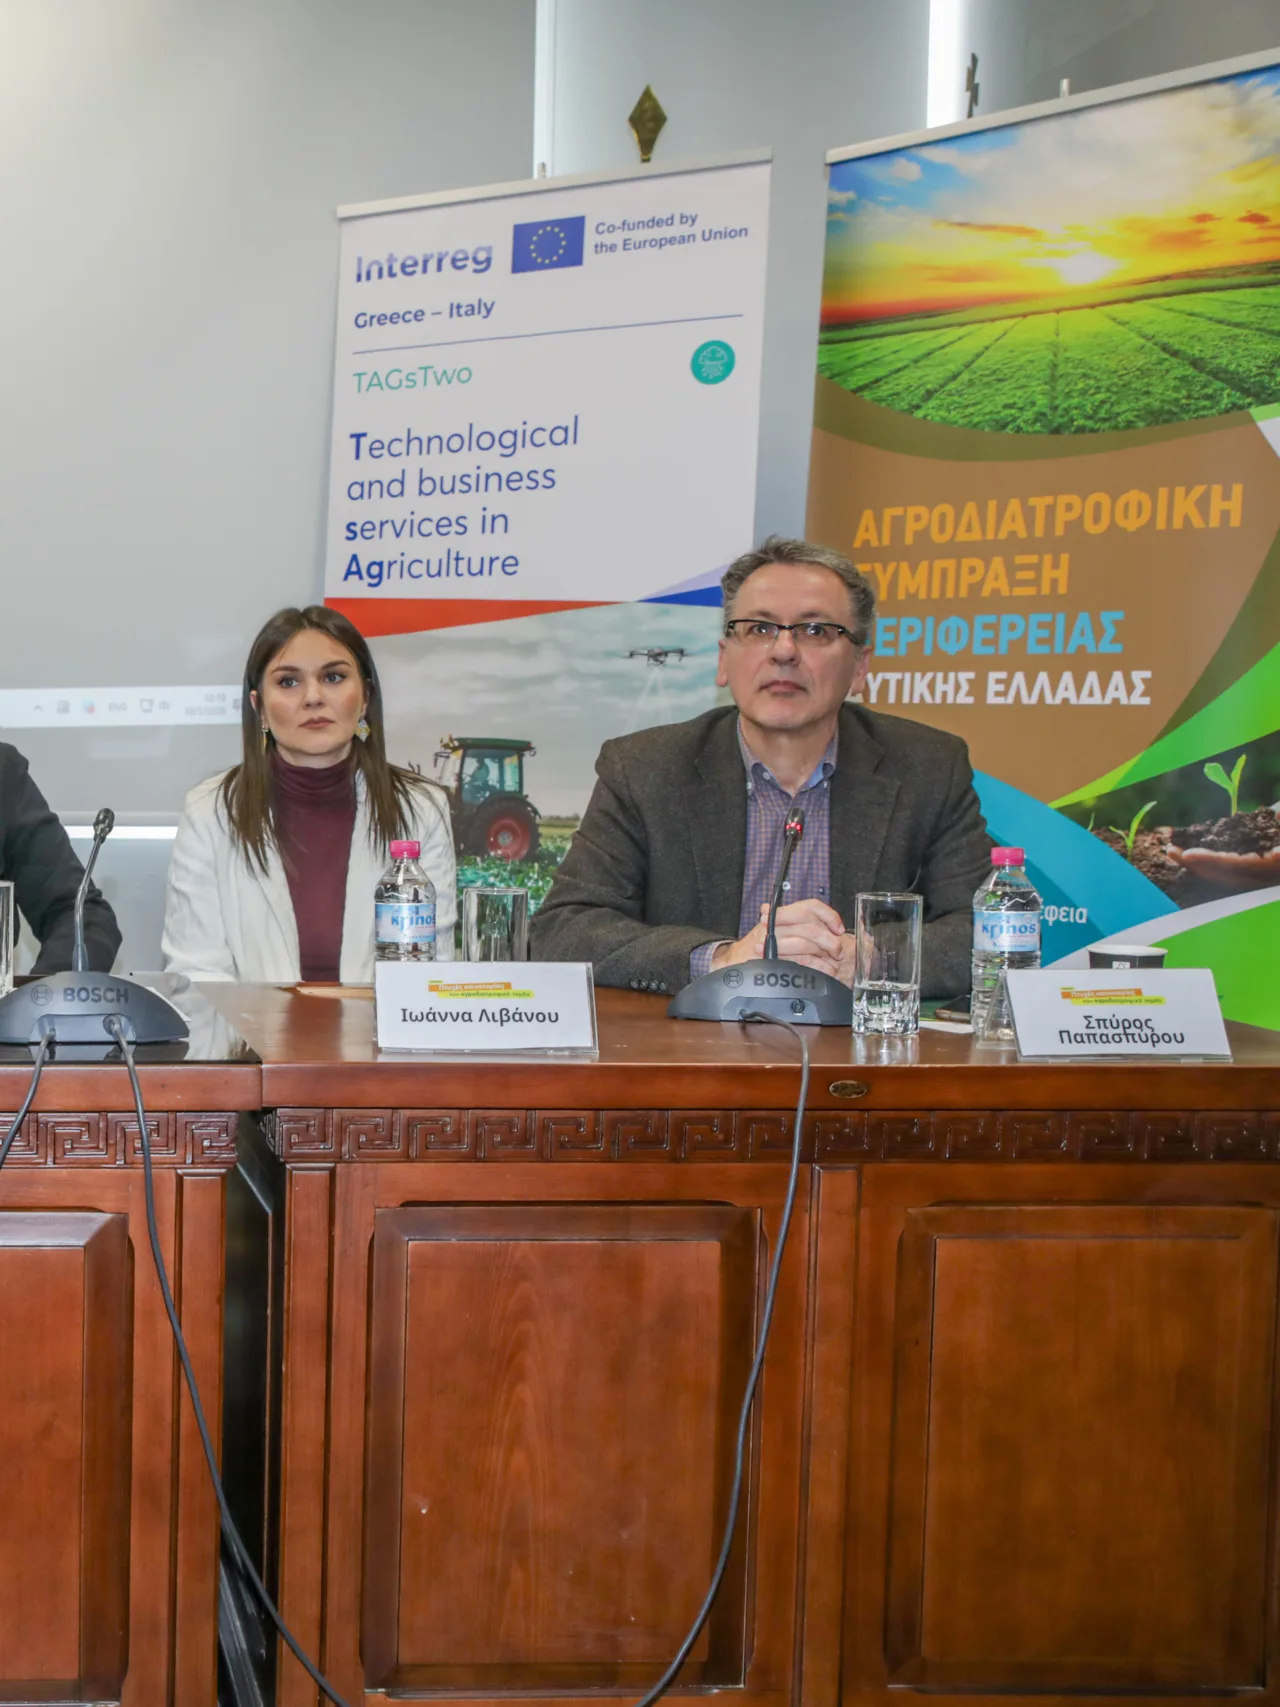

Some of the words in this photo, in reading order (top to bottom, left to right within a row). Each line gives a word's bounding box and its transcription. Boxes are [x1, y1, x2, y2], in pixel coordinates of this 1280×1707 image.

[594, 213, 675, 235] Co-funded
[680, 212, 698, 228] by
[594, 241, 618, 255] the
[623, 232, 696, 250] European
[702, 226, 749, 242] Union
[355, 244, 494, 284] Interreg
[353, 306, 426, 329] Greece
[449, 298, 495, 321] Italy
[352, 365, 473, 394] TAGsTwo
[349, 415, 580, 461] Technological
[347, 469, 406, 501] and
[417, 465, 556, 497] business
[344, 511, 468, 541] services
[480, 506, 510, 535] in
[852, 483, 1244, 549] ΑΓΡΟΔΙΑΤΡΟΦΙΚΗ
[342, 546, 520, 587] Agriculture
[865, 610, 1125, 657] ΕΡΙΦΕΡΕΙΑΣ
[845, 670, 976, 705] ΥΤΙΚΗΣ
[986, 670, 1152, 705] ΕΛΛΑΔΑΣ
[62, 986, 130, 1003] BOSCH
[753, 972, 816, 990] BOSCH
[401, 1006, 473, 1023] Ιωάννα
[478, 1006, 559, 1027] Λιβάνου
[1083, 1014, 1155, 1032] Σπύρος
[1058, 1029, 1186, 1048] Παπασπύρου
